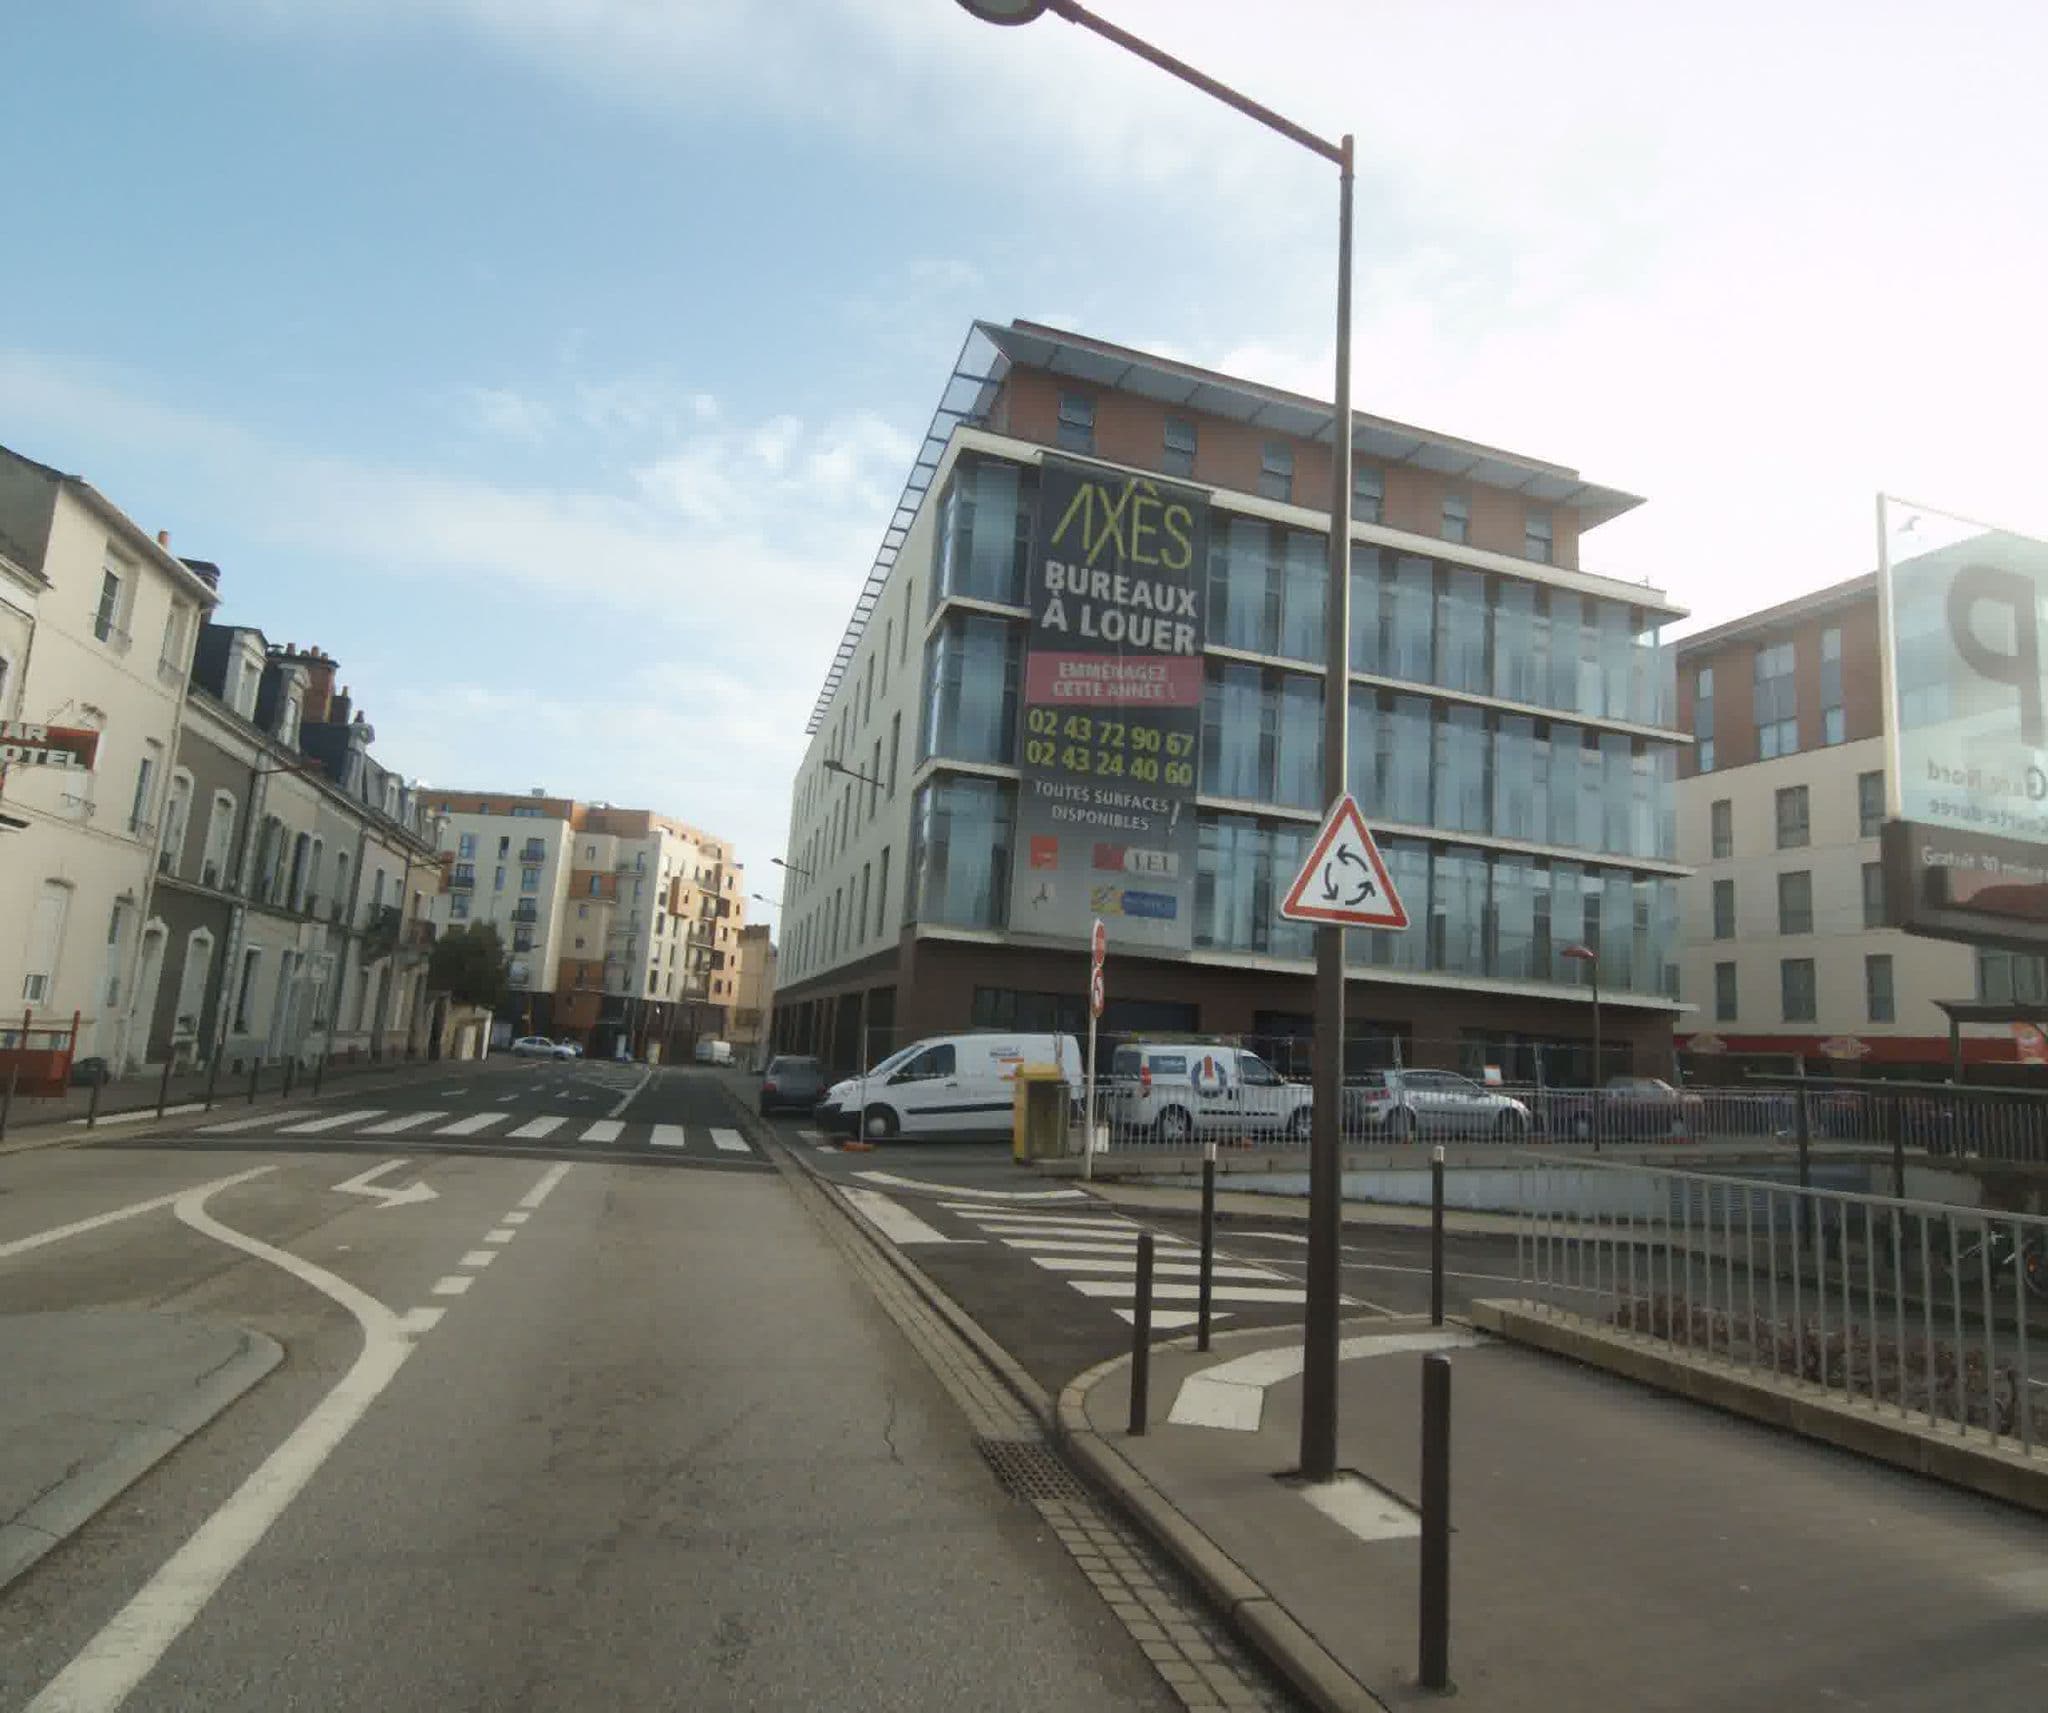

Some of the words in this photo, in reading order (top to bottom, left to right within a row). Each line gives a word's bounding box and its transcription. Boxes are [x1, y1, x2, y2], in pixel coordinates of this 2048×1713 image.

[1044, 559, 1199, 618] BUREAUX
[1040, 589, 1069, 633] À
[1079, 603, 1197, 656] LOUER
[0, 719, 47, 742] AR
[1028, 708, 1058, 736] 02
[1063, 715, 1092, 742] 43
[1099, 720, 1126, 748] 72
[1130, 725, 1161, 752] 90
[1165, 732, 1194, 757] 67
[1027, 739, 1056, 766] 02
[1062, 746, 1090, 771] 43
[1097, 751, 1125, 777] 24
[1130, 757, 1159, 782] 40
[1164, 761, 1193, 785] 60
[1034, 780, 1090, 801] TOUTES
[1094, 789, 1169, 813] SURFACES
[1051, 804, 1151, 832] DISPONIBLES
